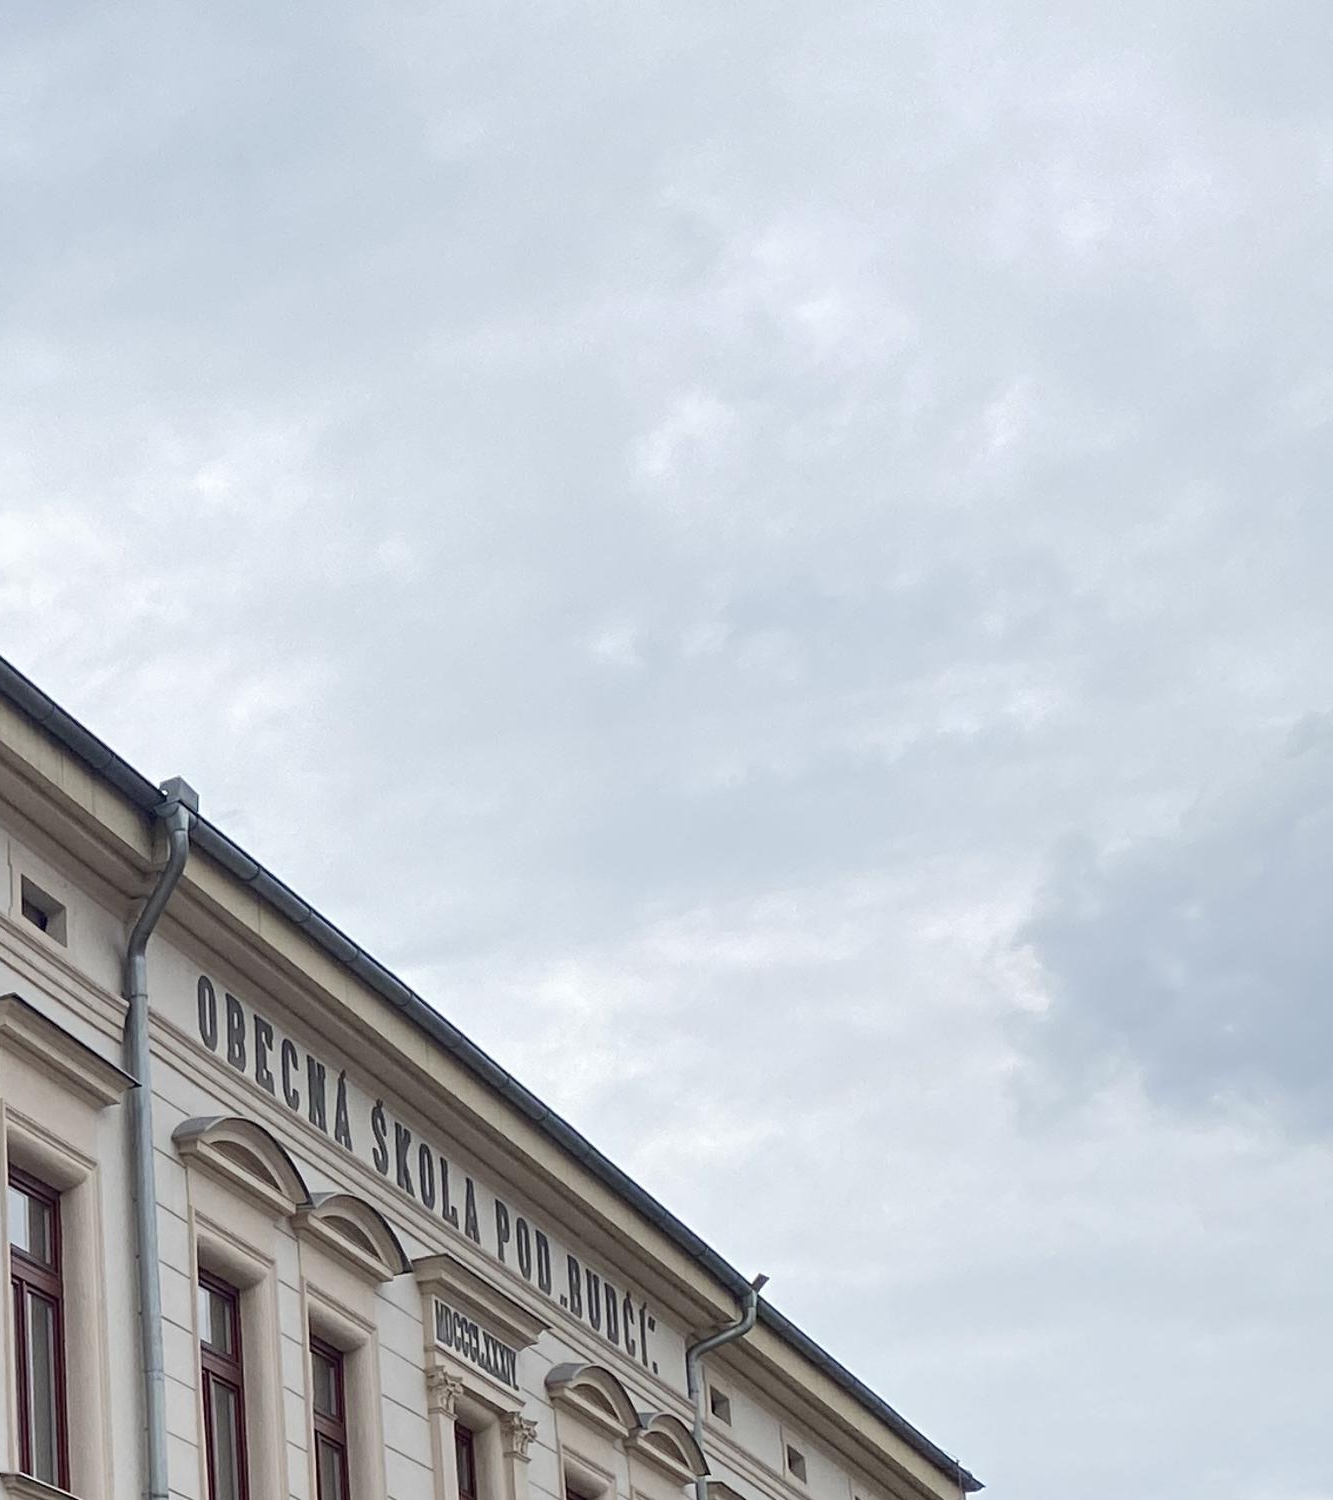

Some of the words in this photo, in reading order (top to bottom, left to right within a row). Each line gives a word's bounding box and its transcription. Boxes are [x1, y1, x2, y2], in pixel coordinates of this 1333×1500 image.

[197, 974, 353, 1152] OBECNÁ
[371, 1098, 481, 1245] ŠKOLA
[495, 1198, 552, 1296] POD
